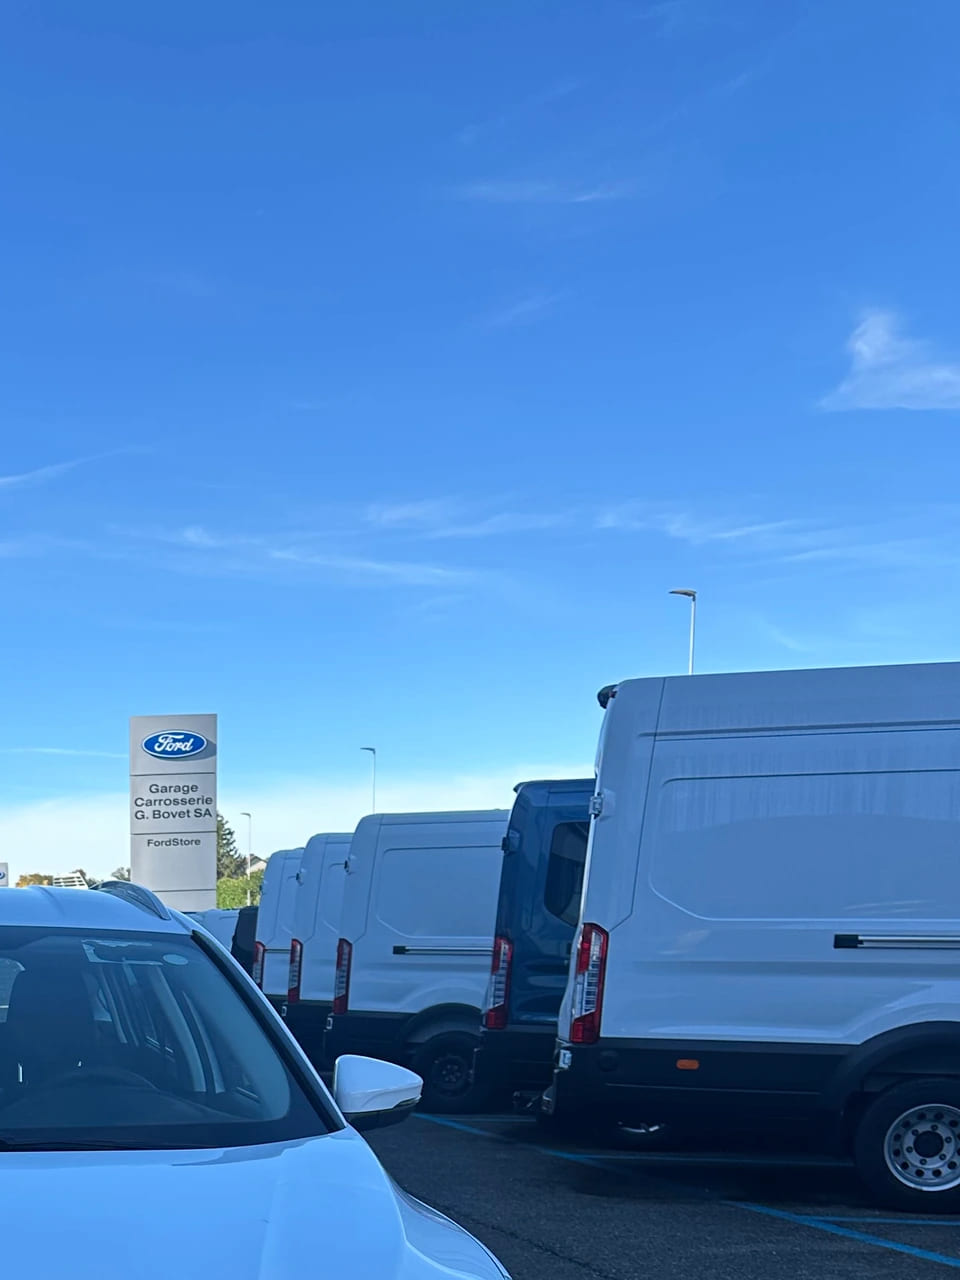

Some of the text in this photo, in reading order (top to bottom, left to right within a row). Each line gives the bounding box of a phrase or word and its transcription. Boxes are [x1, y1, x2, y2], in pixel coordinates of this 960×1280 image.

[153, 734, 194, 752] Ford
[149, 783, 199, 795] Garage
[134, 795, 214, 807] Carrosserie
[134, 808, 213, 820] G. Bovet SA
[147, 837, 202, 847] FordStore
